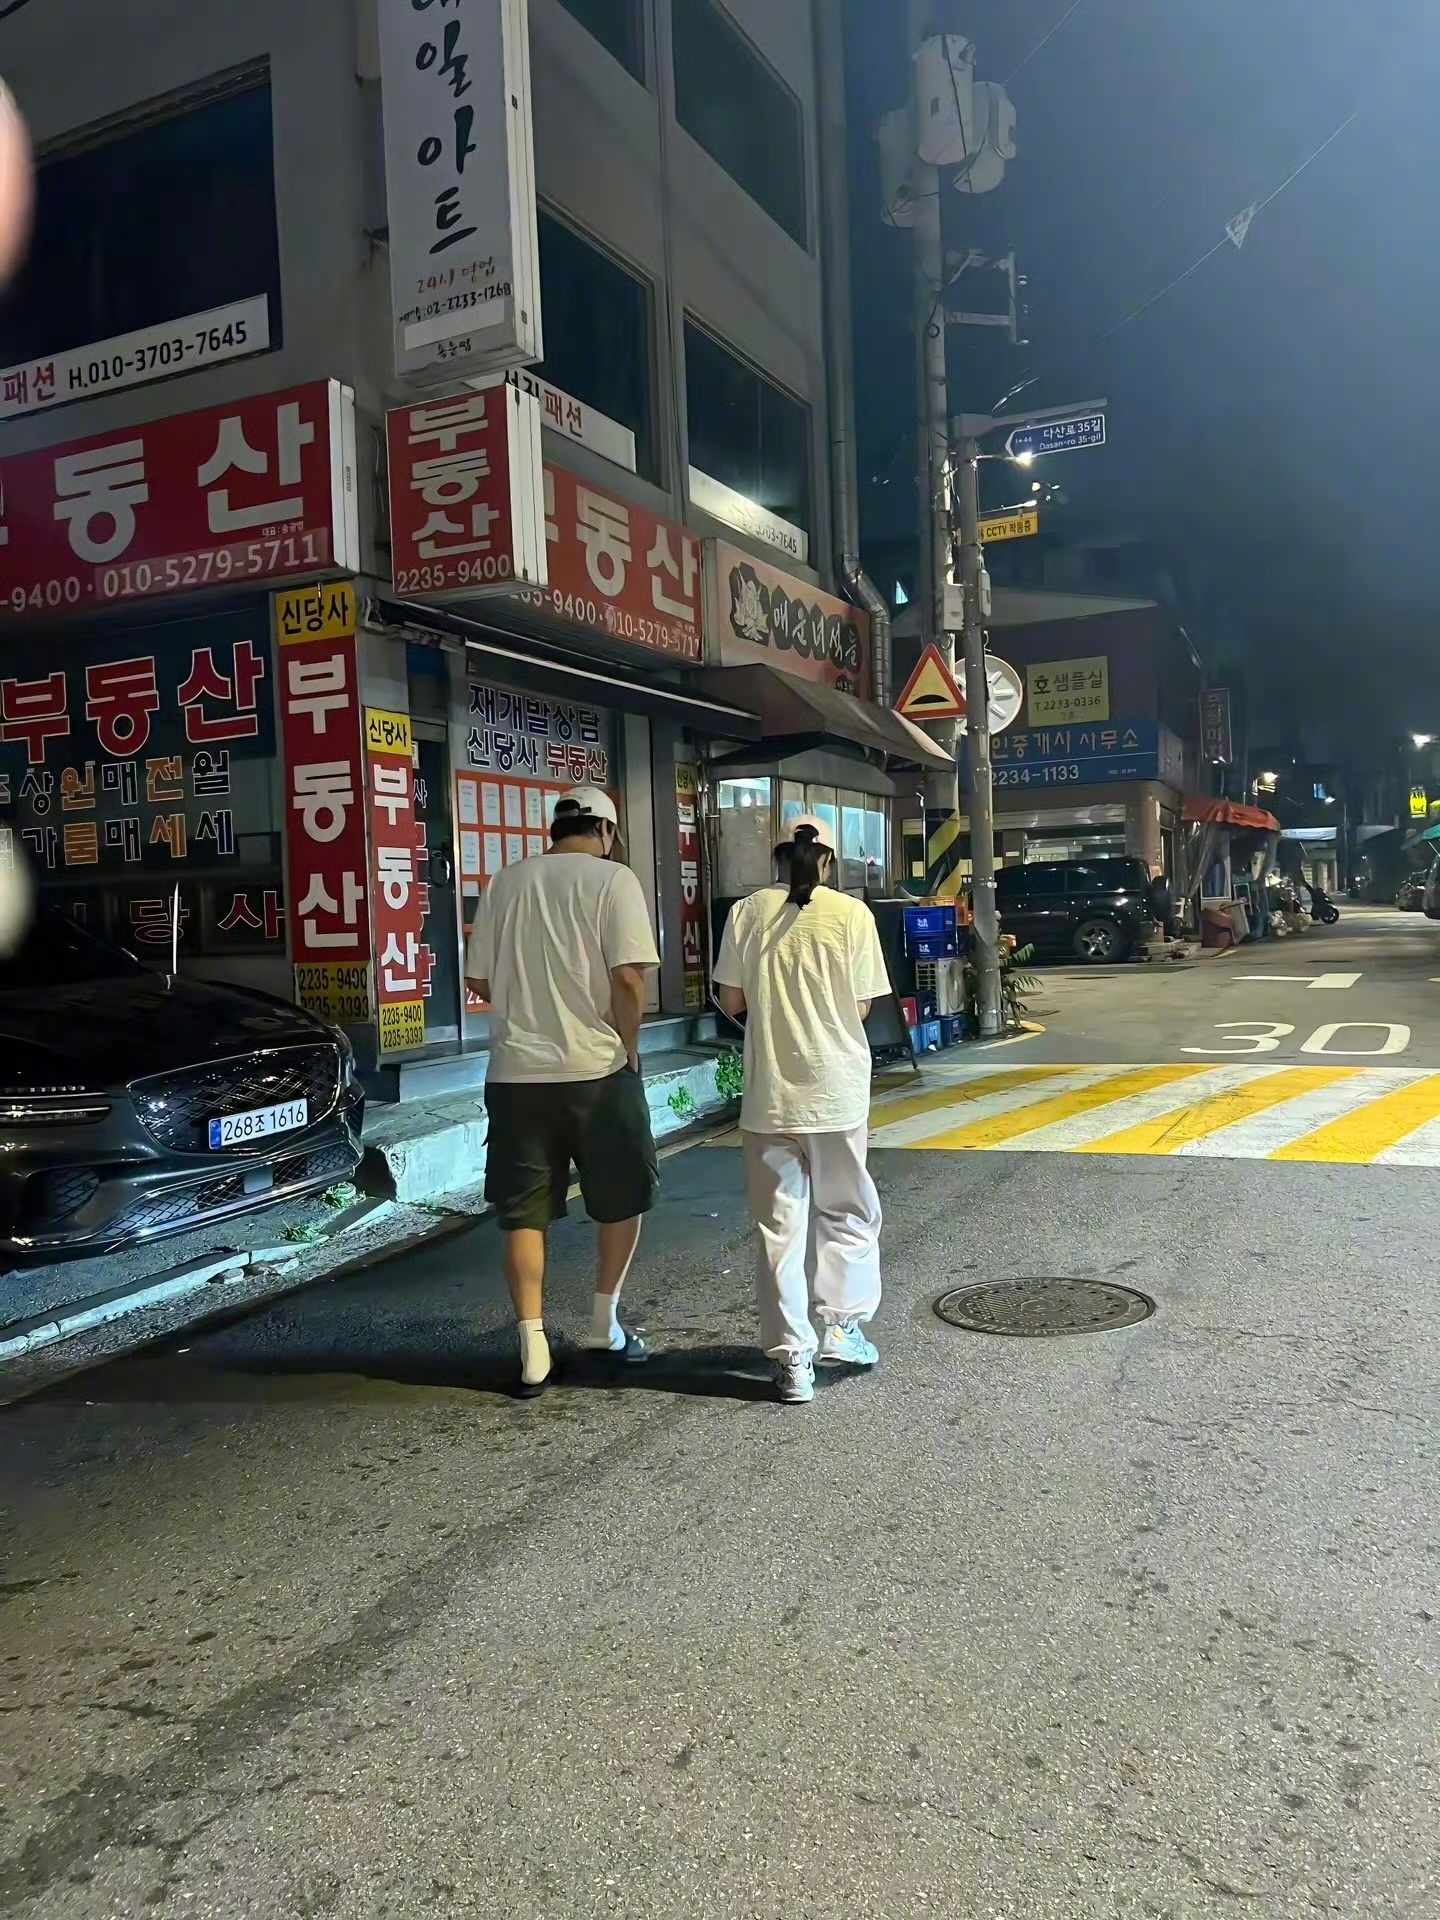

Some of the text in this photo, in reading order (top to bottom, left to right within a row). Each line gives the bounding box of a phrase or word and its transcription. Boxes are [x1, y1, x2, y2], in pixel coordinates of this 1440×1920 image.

[407, 0, 478, 254] 일아트
[3, 320, 247, 404] 패션 H.010-3703-7645
[544, 389, 584, 438] 패션
[1040, 433, 1101, 450] Dasan-ro 35-gil
[0, 402, 315, 563] 동산
[408, 395, 499, 559] 부동산
[986, 524, 1007, 537] CCTV
[103, 535, 318, 597] 010-5279-5711
[397, 554, 511, 593] 2235-9400
[281, 591, 349, 635] 신당사
[1, 640, 265, 764] 부동산
[469, 683, 601, 744] 재개발상담
[369, 717, 408, 749] 신당사
[467, 727, 540, 775] 신당사
[546, 740, 608, 785] 부동산
[1079, 728, 1140, 752] 사무소
[288, 654, 364, 950] 부동산
[374, 763, 420, 993] 부동산
[299, 967, 368, 991] 2235-9400
[382, 1005, 422, 1026] 2235-9400
[383, 1027, 423, 1048] 2235-3393
[1180, 1021, 1411, 1055] 30
[270, 1103, 305, 1131] 1616
